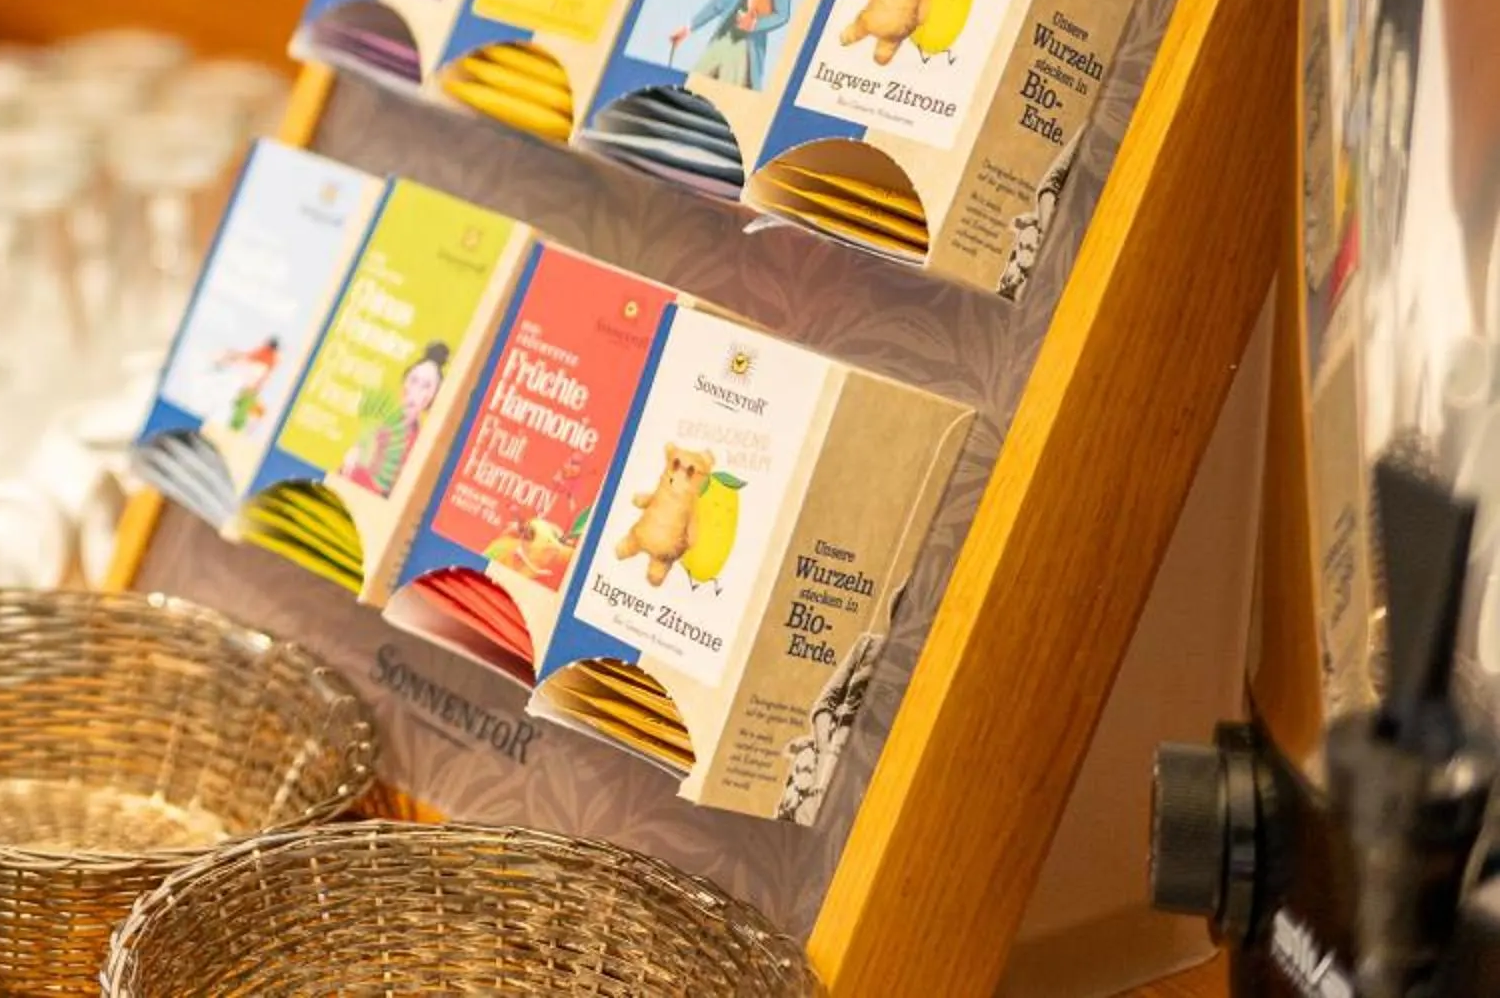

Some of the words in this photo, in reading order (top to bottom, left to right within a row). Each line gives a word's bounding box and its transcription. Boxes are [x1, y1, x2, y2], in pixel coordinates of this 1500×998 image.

[1033, 23, 1103, 81] Wurzeln
[814, 62, 881, 96] Ingwer
[883, 81, 958, 117] Zitrone
[1020, 69, 1063, 109] Bio-
[1019, 104, 1064, 146] Erde.
[502, 346, 590, 411] Früchte
[475, 413, 530, 465] Fruit
[489, 379, 599, 454] Harmonie
[463, 448, 559, 518] Harmony
[796, 555, 874, 596] Wurzeln
[592, 574, 655, 617] Ingwer
[656, 605, 723, 652] Zitrone
[784, 601, 832, 634] Bio-
[786, 633, 836, 667] Erde.
